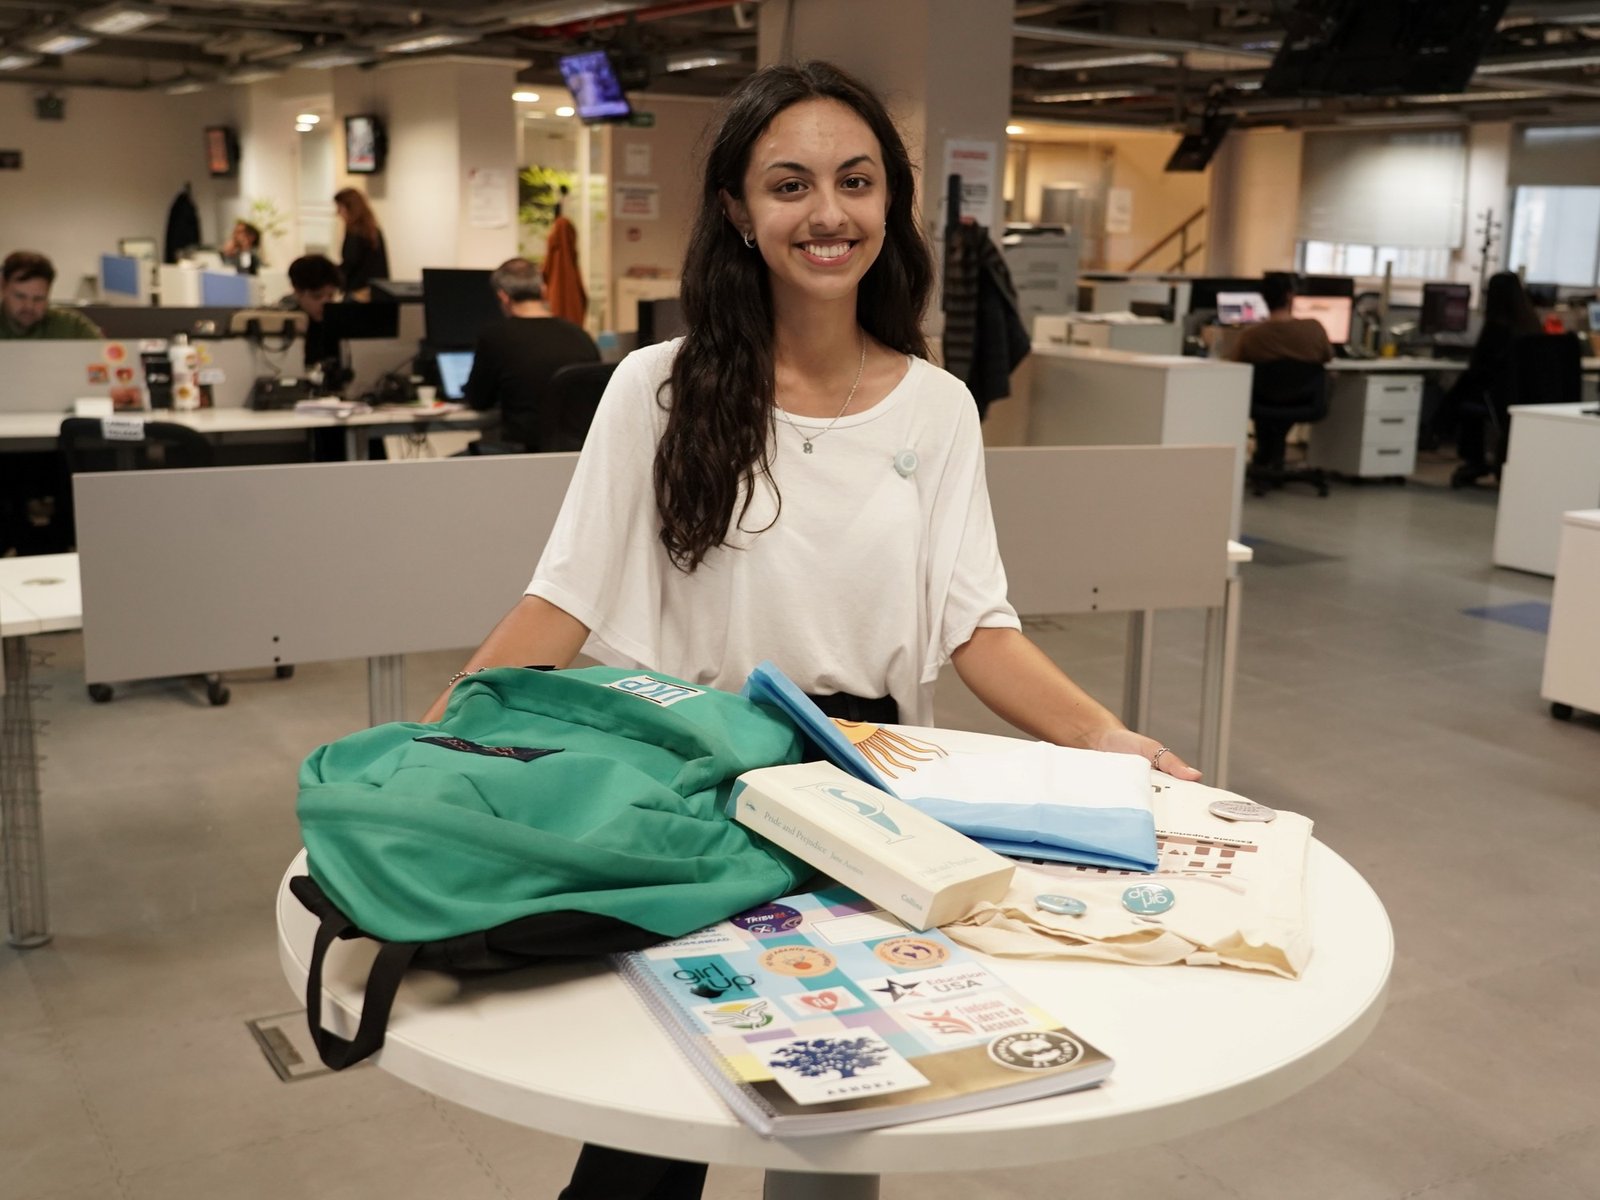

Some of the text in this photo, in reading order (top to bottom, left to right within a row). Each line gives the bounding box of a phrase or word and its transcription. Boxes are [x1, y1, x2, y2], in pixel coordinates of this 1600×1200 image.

[763, 810, 783, 830] Pride
[783, 819, 796, 837] and
[796, 827, 827, 855] Prejudice
[673, 962, 724, 985] girl
[925, 969, 987, 987] Education
[932, 979, 983, 994] USA
